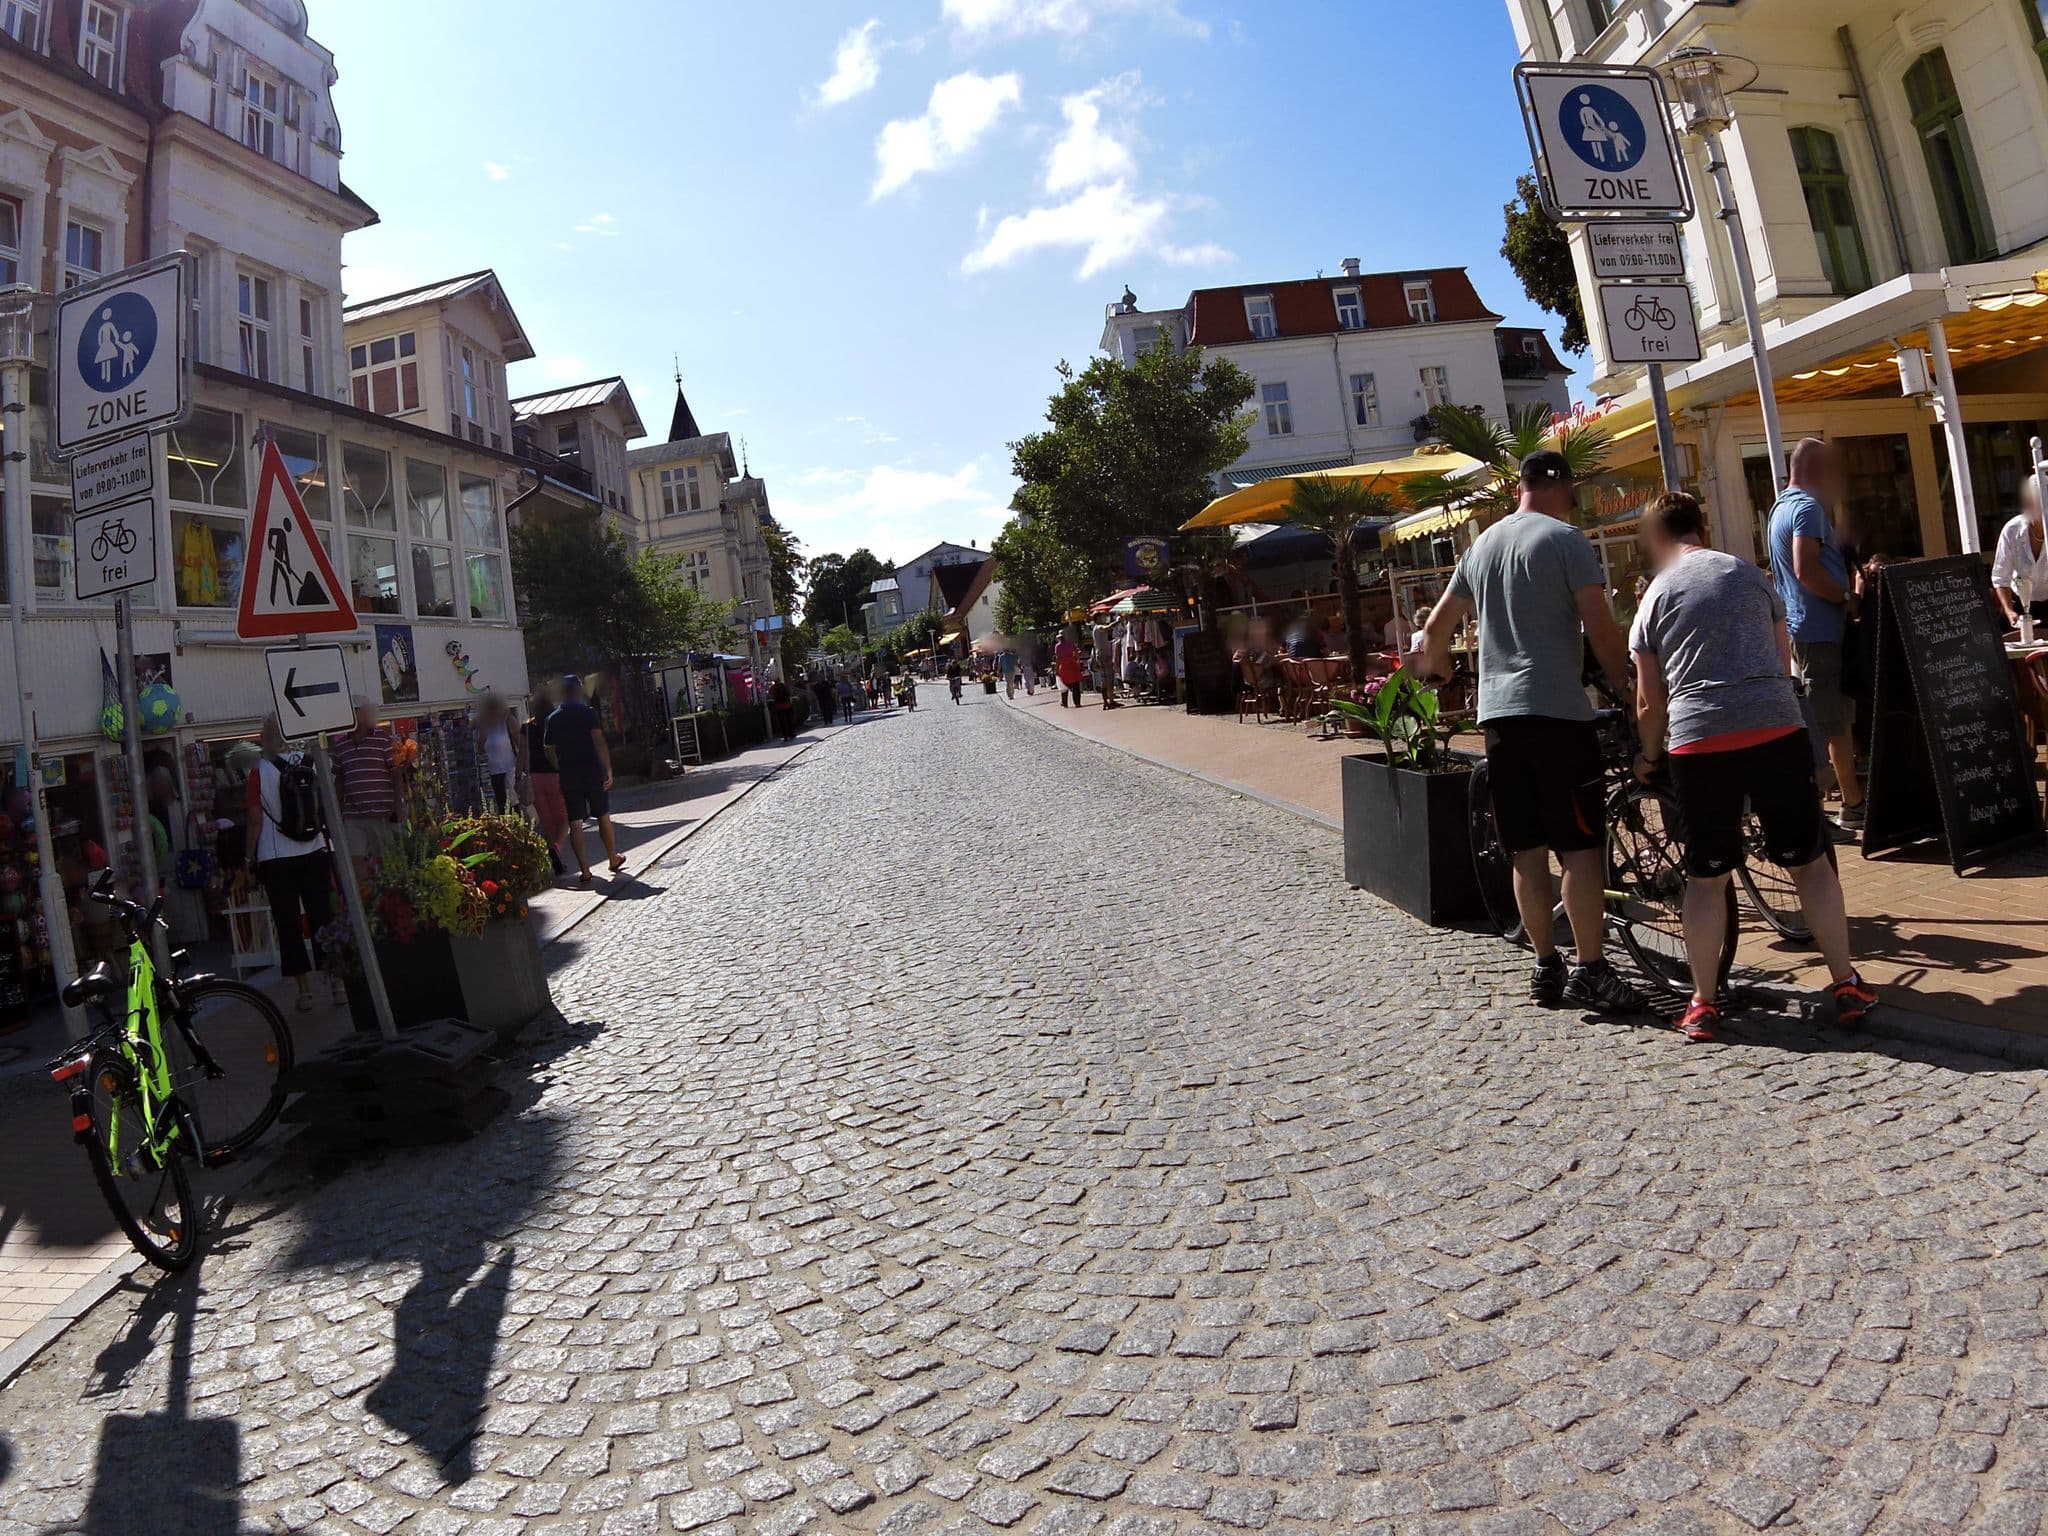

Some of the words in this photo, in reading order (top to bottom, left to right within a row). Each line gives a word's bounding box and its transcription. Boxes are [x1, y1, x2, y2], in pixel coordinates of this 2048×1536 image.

[1584, 178, 1652, 200] ZONE
[1593, 232, 1653, 246] Lieferverkehr
[1658, 232, 1674, 245] frei
[1600, 256, 1617, 267] von
[1641, 335, 1670, 353] frei
[87, 389, 148, 430] ZONE
[76, 452, 128, 480] Lieferverkehr
[131, 443, 147, 461] frei
[79, 487, 94, 501] von
[102, 559, 128, 584] frei
[1906, 579, 1933, 598] Pasta
